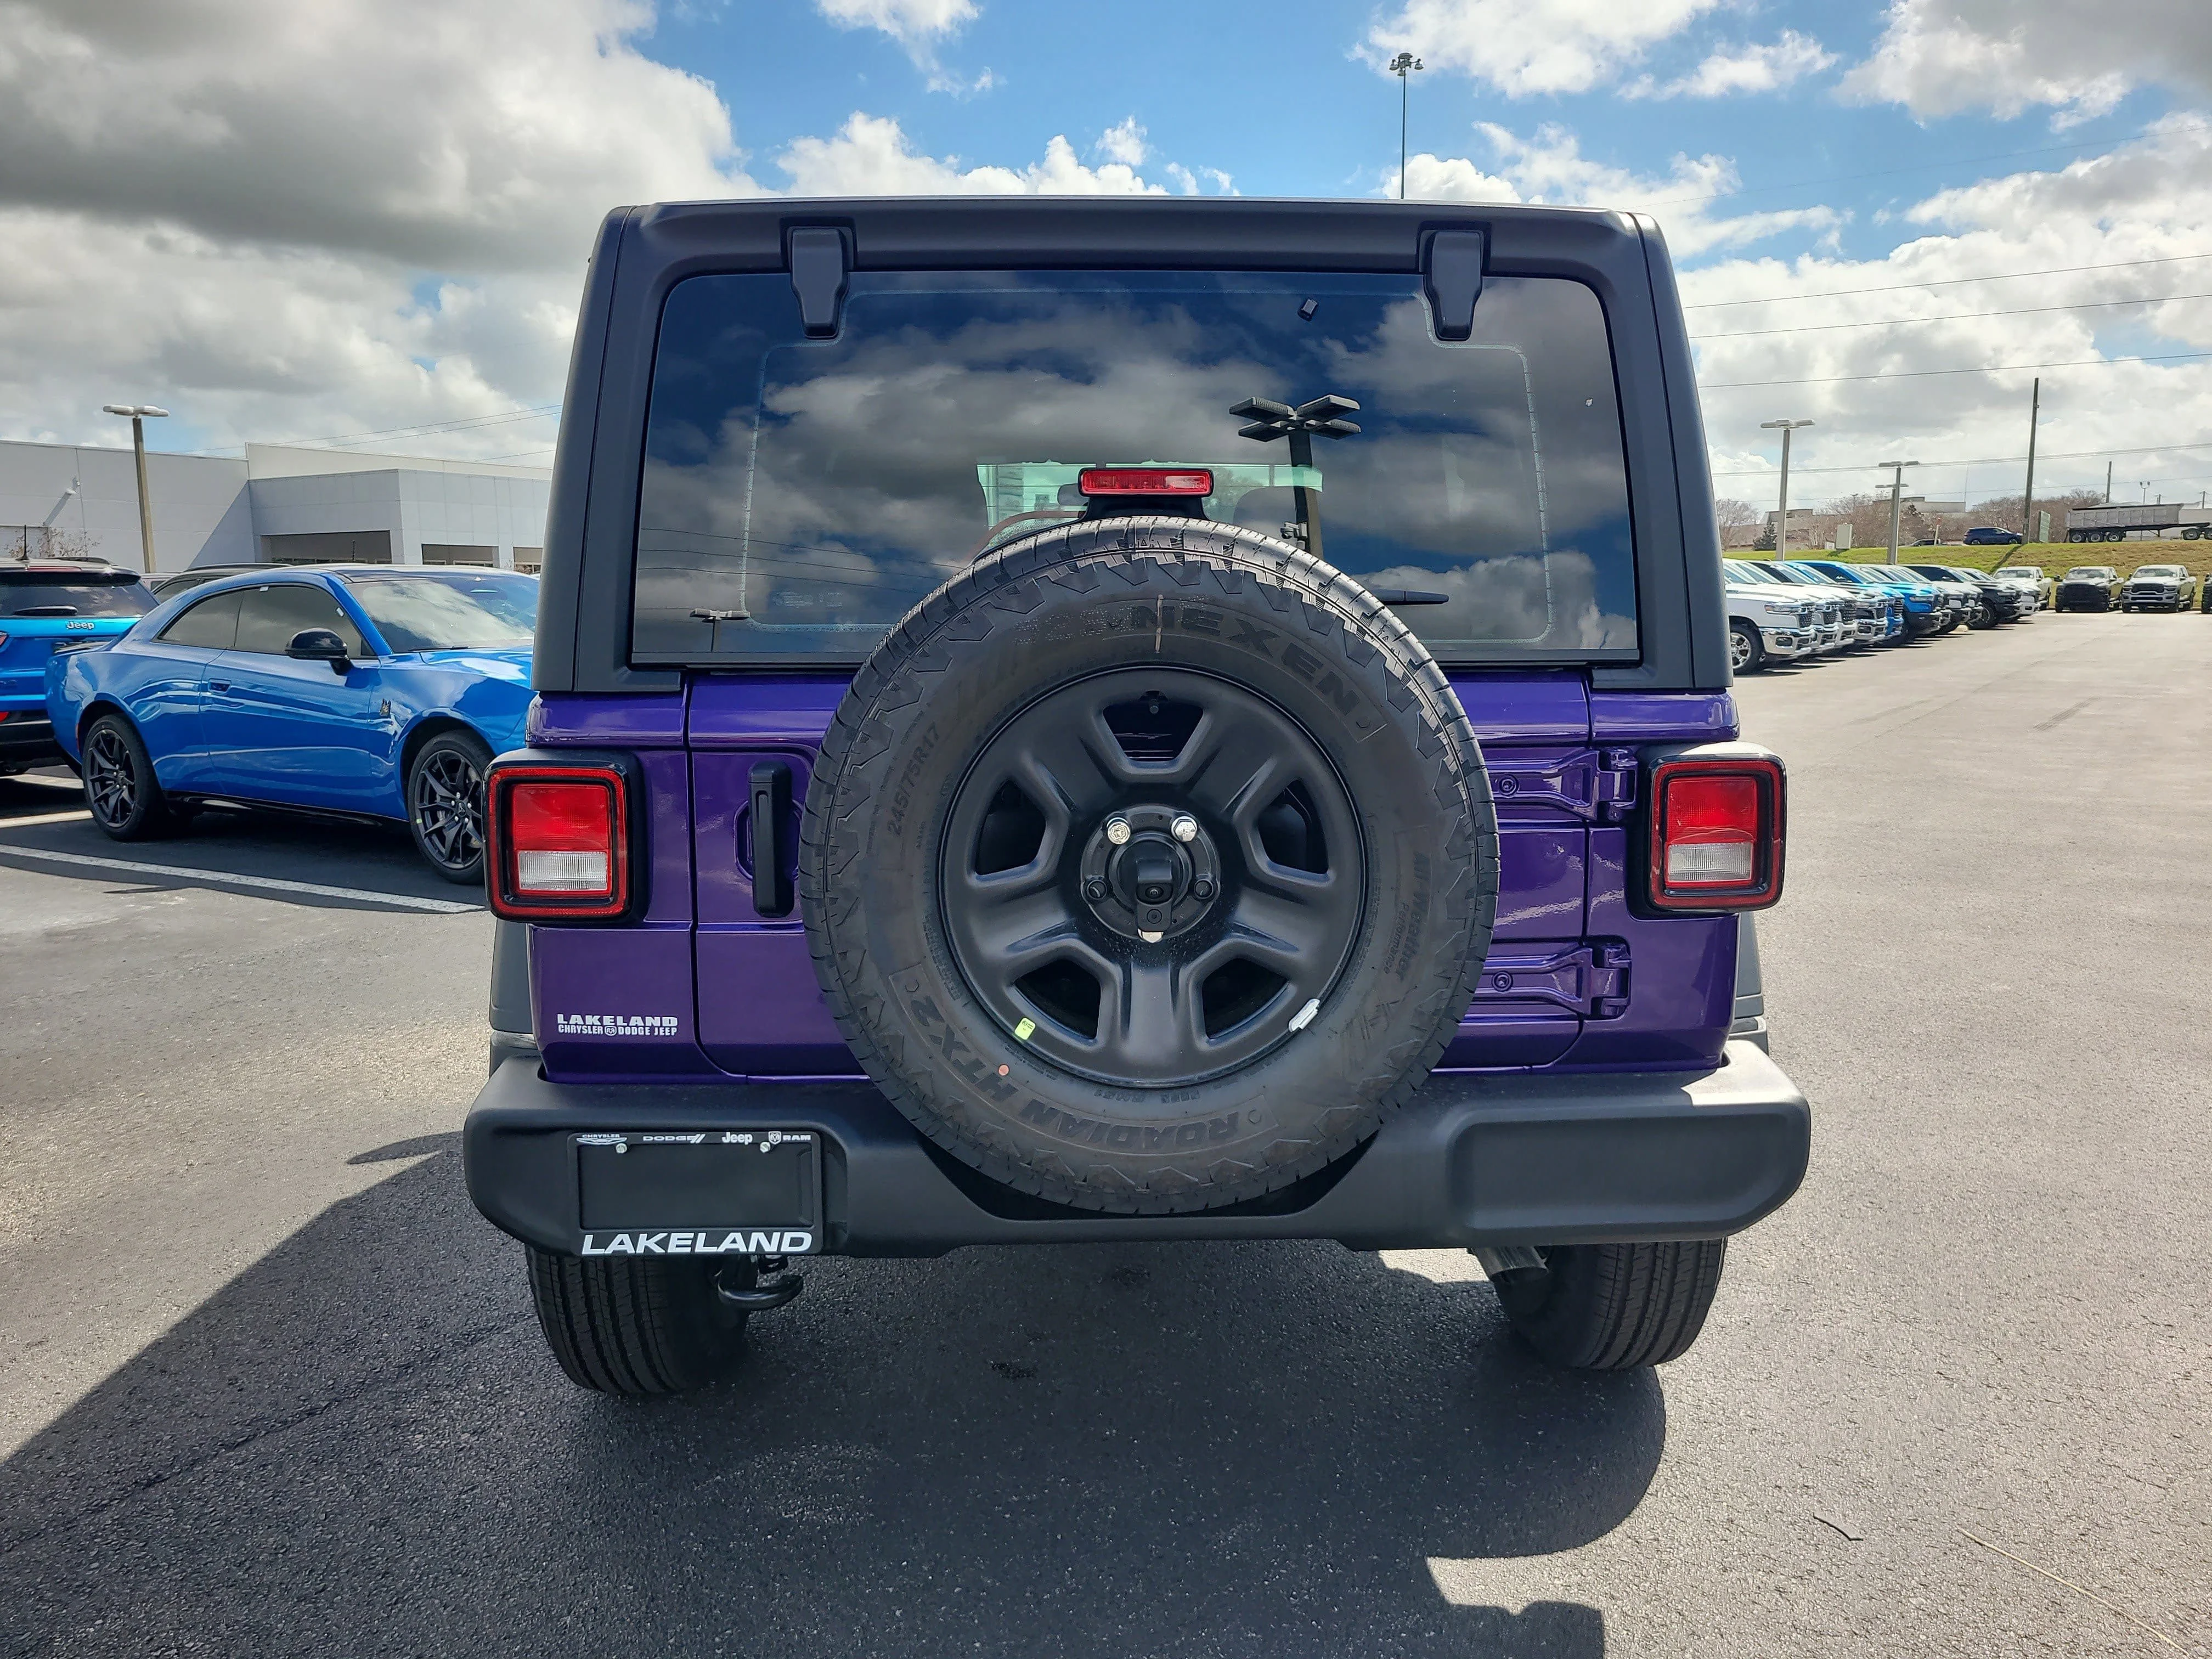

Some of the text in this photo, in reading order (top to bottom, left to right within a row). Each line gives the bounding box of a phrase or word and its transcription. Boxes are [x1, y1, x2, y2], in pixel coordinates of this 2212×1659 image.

[67, 621, 94, 630] Jeep
[1132, 605, 1360, 715] NEXEN
[557, 1014, 678, 1026] LAKELAND
[558, 1024, 678, 1036] CHRYSLER DODGE JEEP
[1019, 1099, 1240, 1149] ROADIAN
[721, 1132, 753, 1145] Jeep
[582, 1232, 812, 1255] LAKELAND
